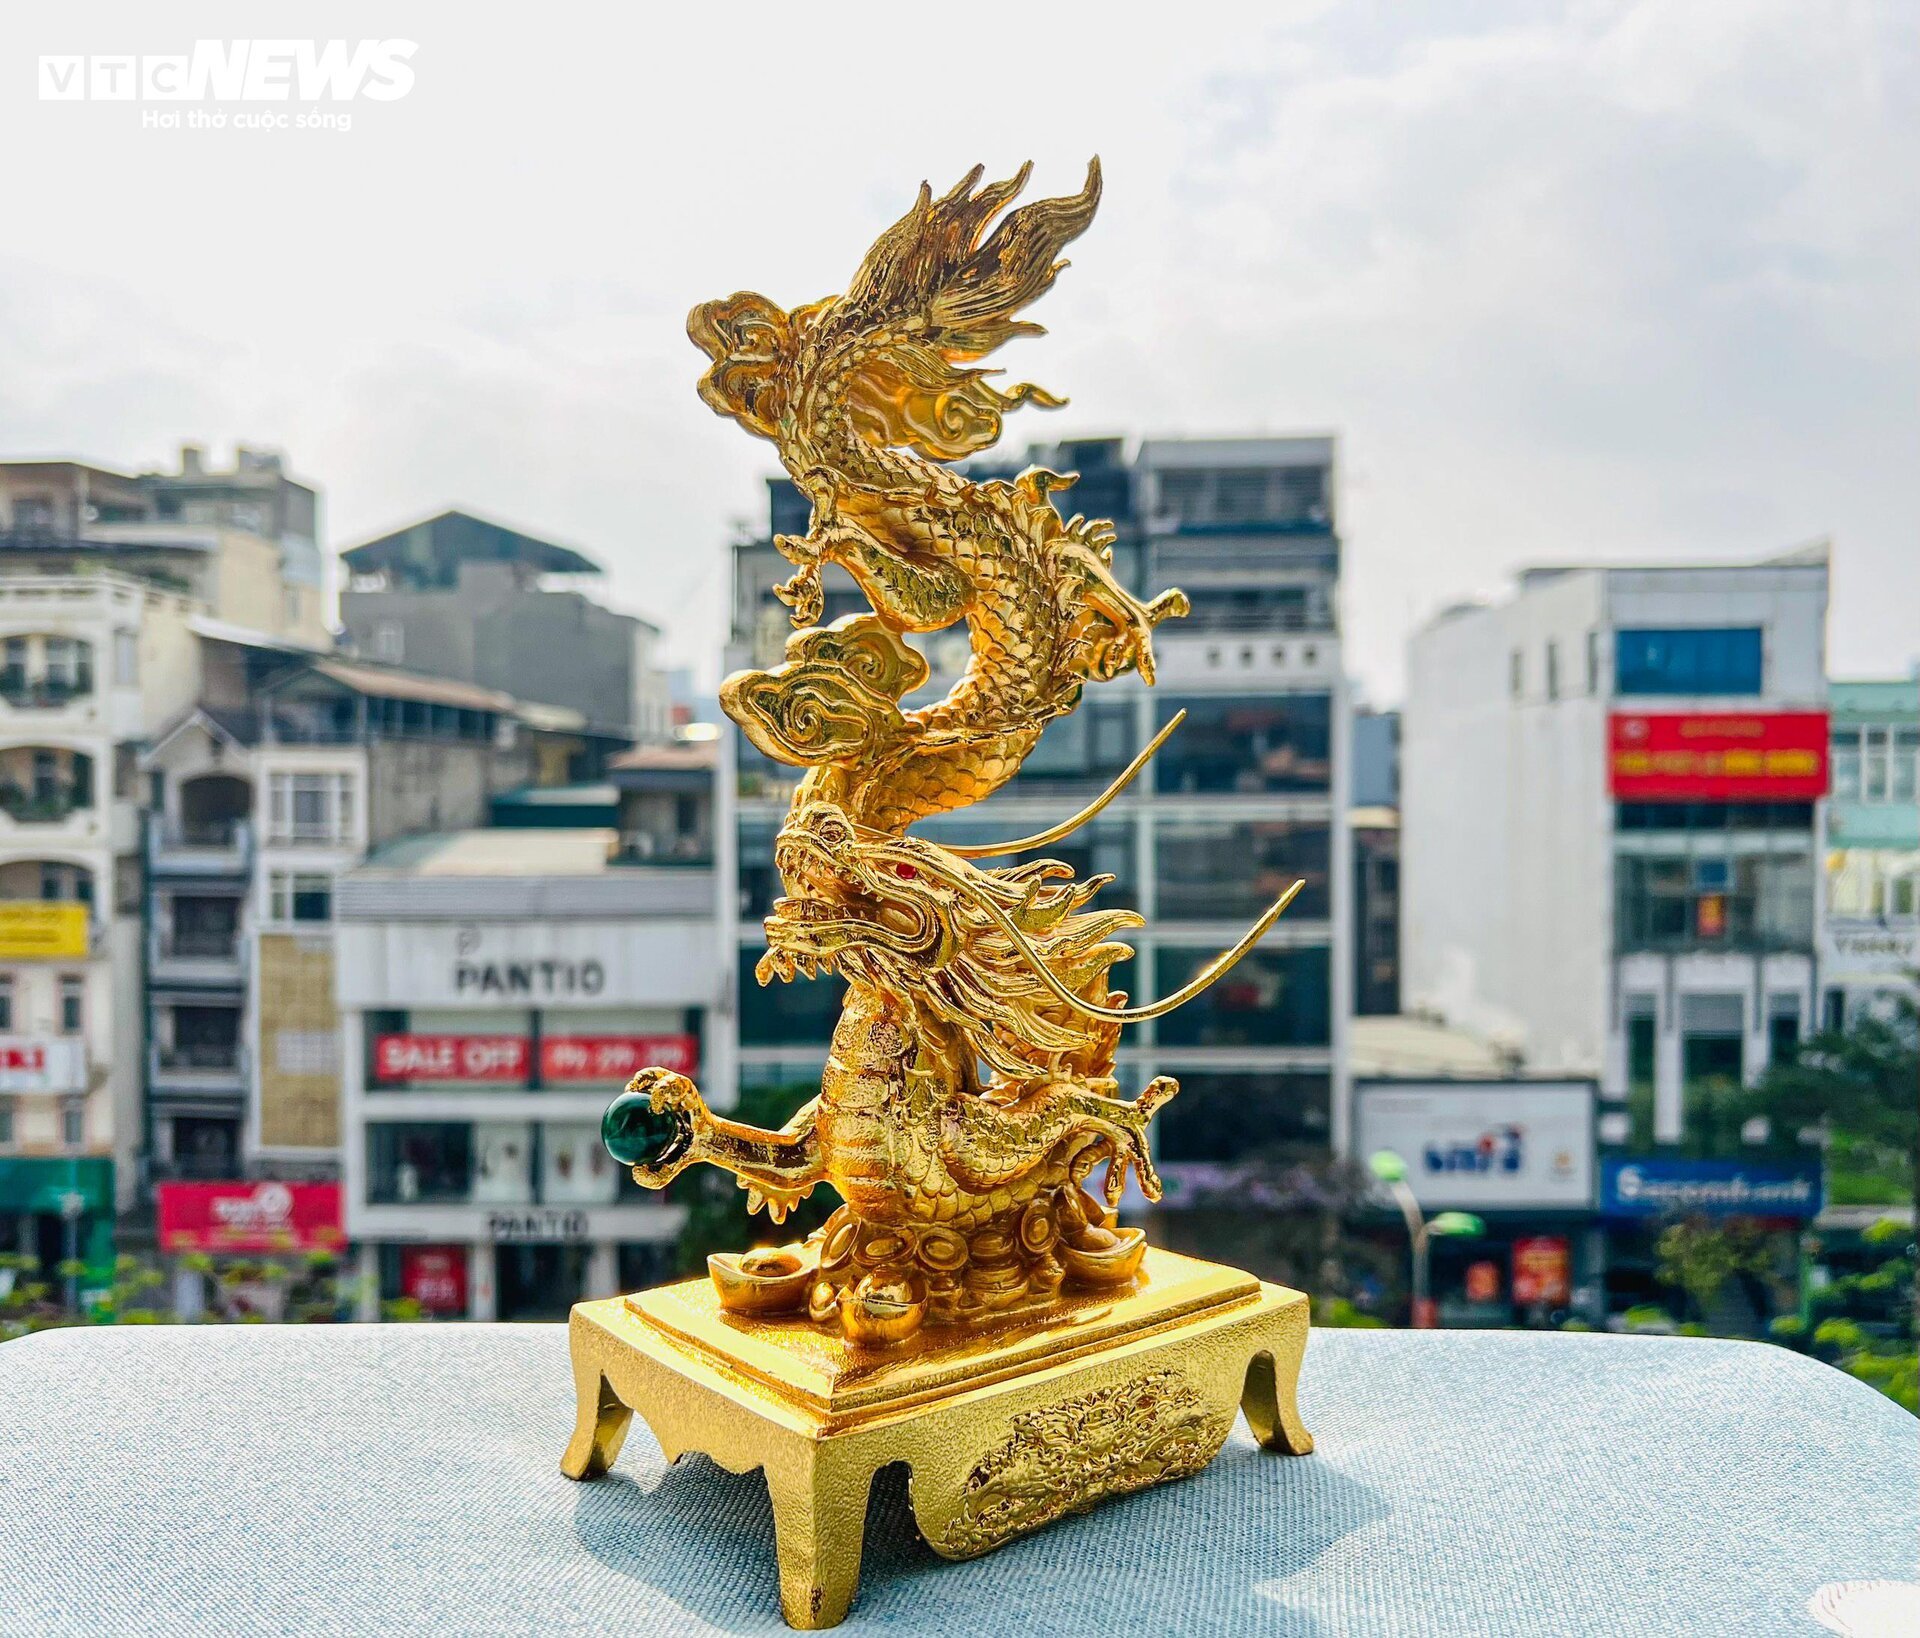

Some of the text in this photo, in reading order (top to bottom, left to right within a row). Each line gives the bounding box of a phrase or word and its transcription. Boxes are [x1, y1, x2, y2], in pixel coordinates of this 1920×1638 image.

[456, 960, 606, 995] PANTIO
[384, 1040, 455, 1074] SALE
[464, 1041, 524, 1073] OFF
